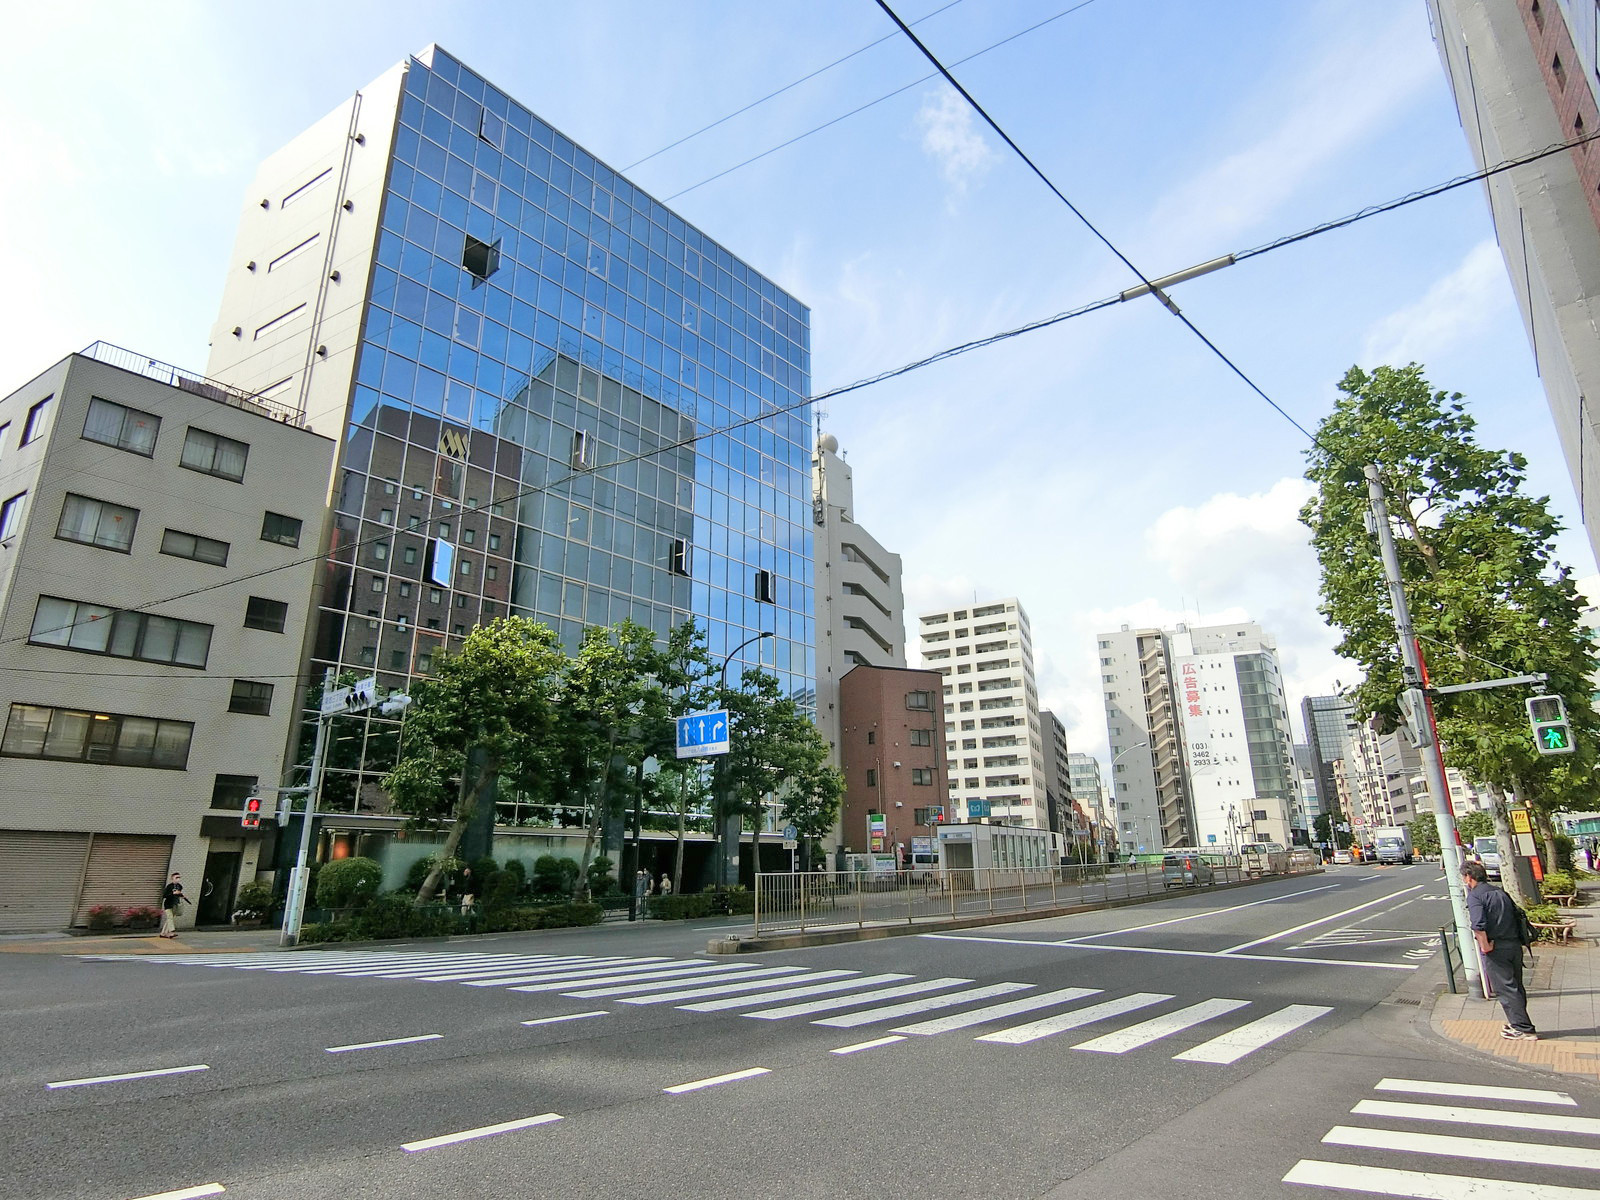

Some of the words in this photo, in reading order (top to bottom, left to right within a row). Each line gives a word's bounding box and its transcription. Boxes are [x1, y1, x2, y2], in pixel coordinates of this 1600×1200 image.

[1182, 663, 1203, 717] 広告募集
[1191, 742, 1208, 750] (03)
